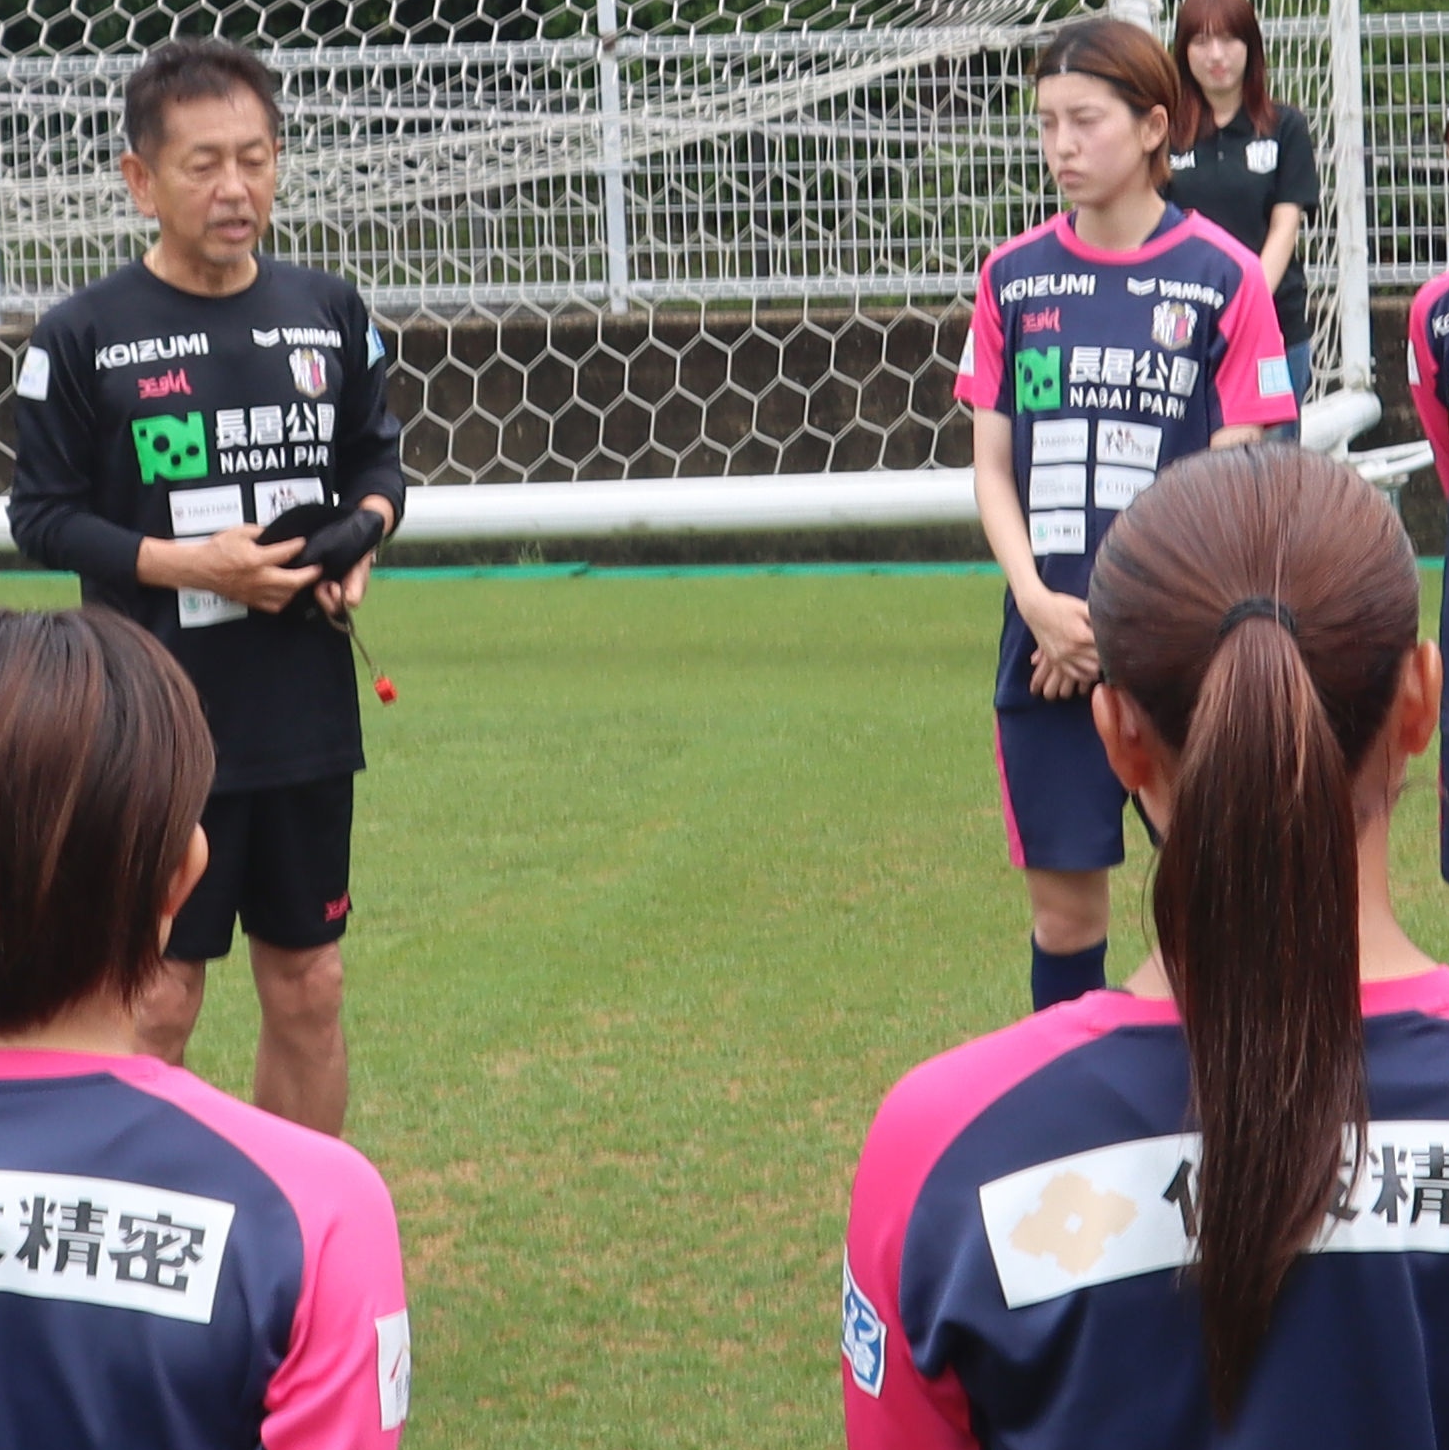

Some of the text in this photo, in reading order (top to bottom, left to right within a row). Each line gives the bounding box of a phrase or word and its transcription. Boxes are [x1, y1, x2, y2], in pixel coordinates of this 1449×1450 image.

[1000, 273, 1096, 305] KOIZUMI
[95, 332, 209, 371] KOIZUMI
[1069, 346, 1199, 398] 長居公園
[1069, 387, 1132, 412] NAGAI
[219, 447, 286, 474] NAGAI
